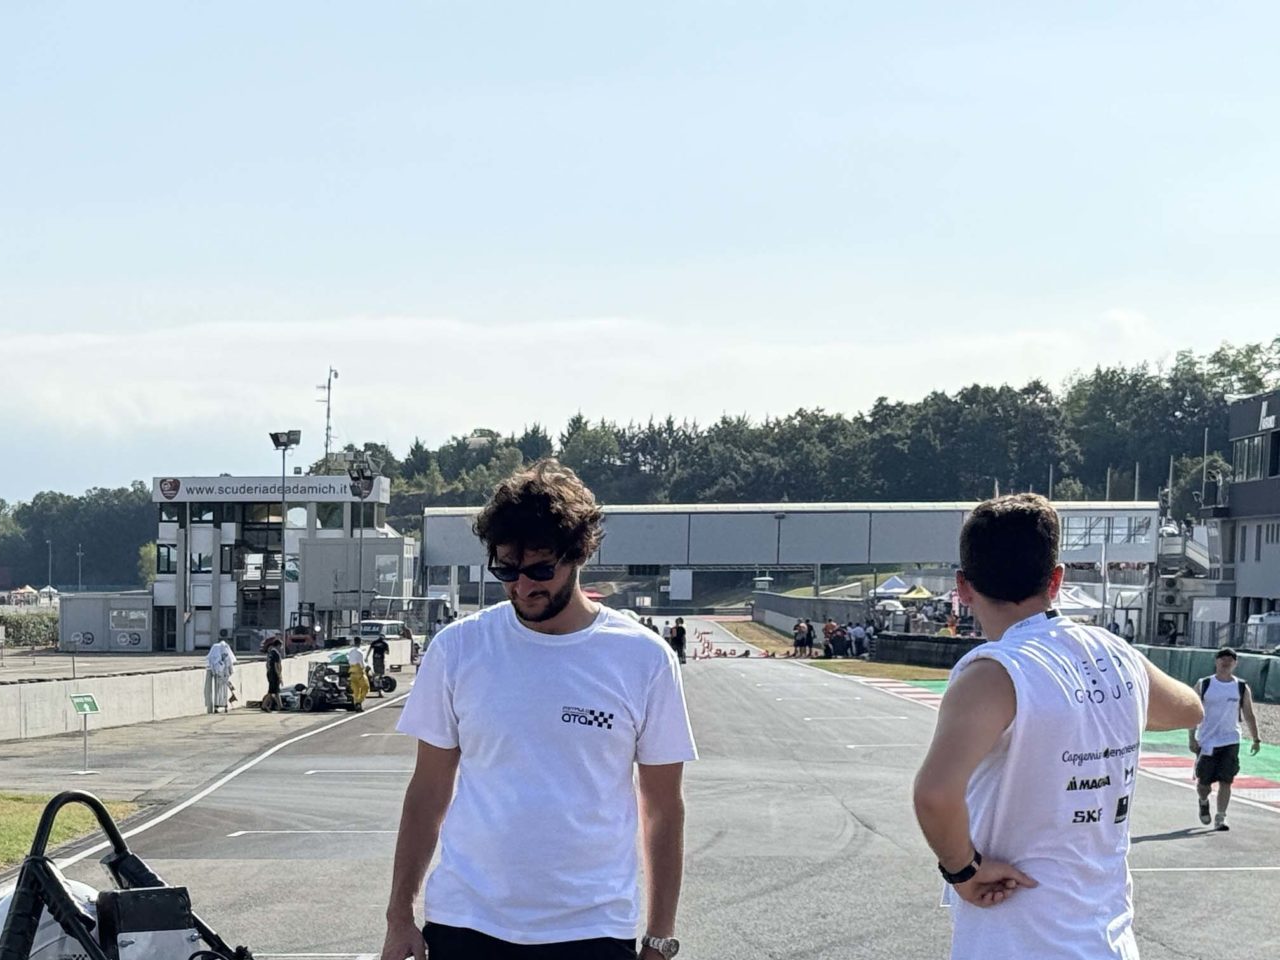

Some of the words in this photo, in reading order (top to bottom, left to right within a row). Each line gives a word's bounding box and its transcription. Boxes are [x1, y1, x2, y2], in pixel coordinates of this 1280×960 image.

[185, 481, 348, 496] www.scuderiadeadamich.it
[1074, 681, 1134, 704] GROUP
[1061, 750, 1103, 766] Capgemi
